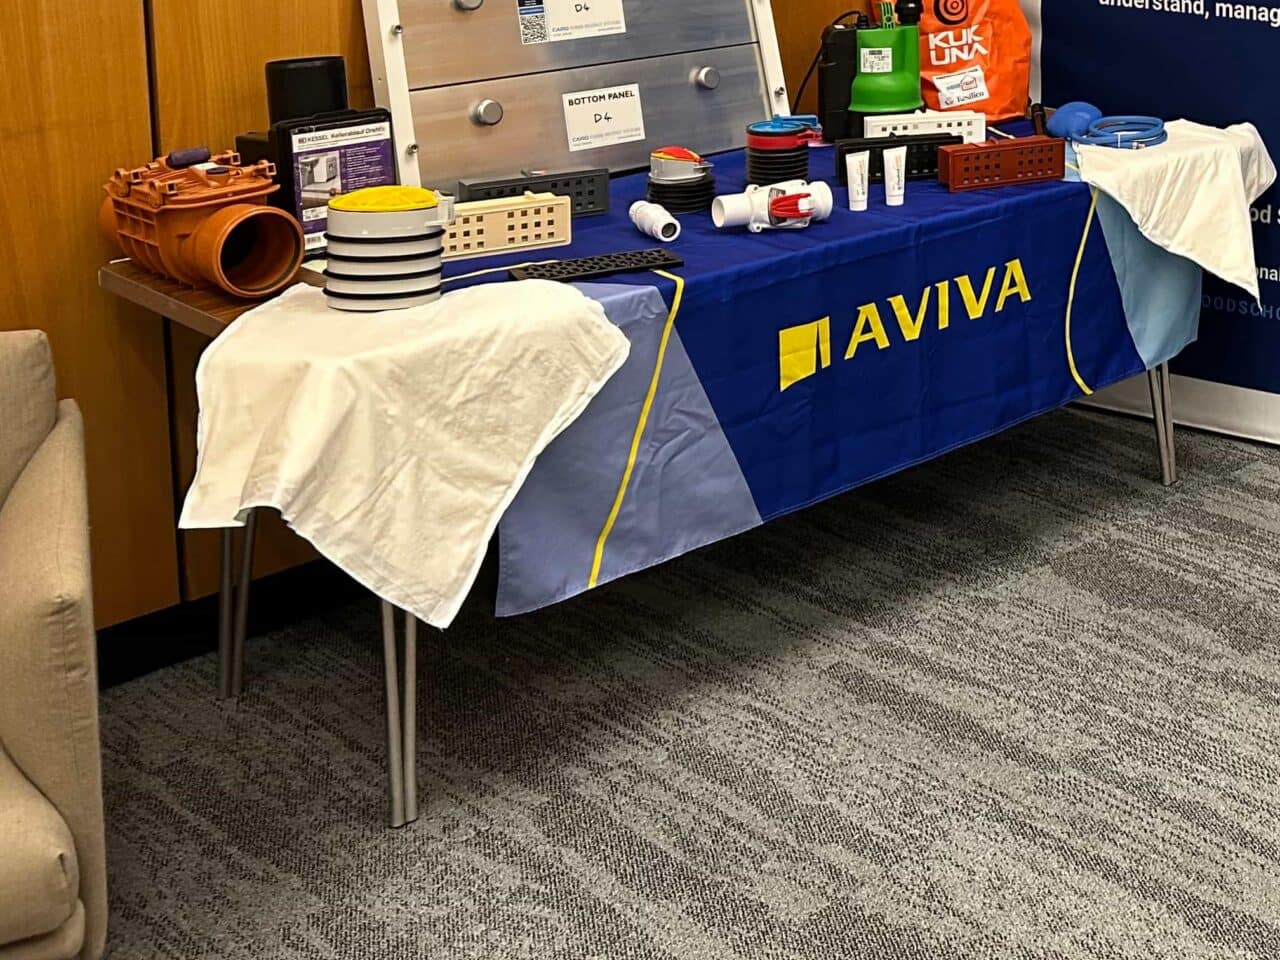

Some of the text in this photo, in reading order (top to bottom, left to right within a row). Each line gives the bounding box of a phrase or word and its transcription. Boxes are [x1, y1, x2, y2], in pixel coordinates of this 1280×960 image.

[574, 3, 590, 12] D4
[568, 91, 635, 106] BOTTOM PANEL
[593, 112, 612, 123] D4
[1250, 204, 1272, 224] od
[845, 259, 1031, 360] AVIVA
